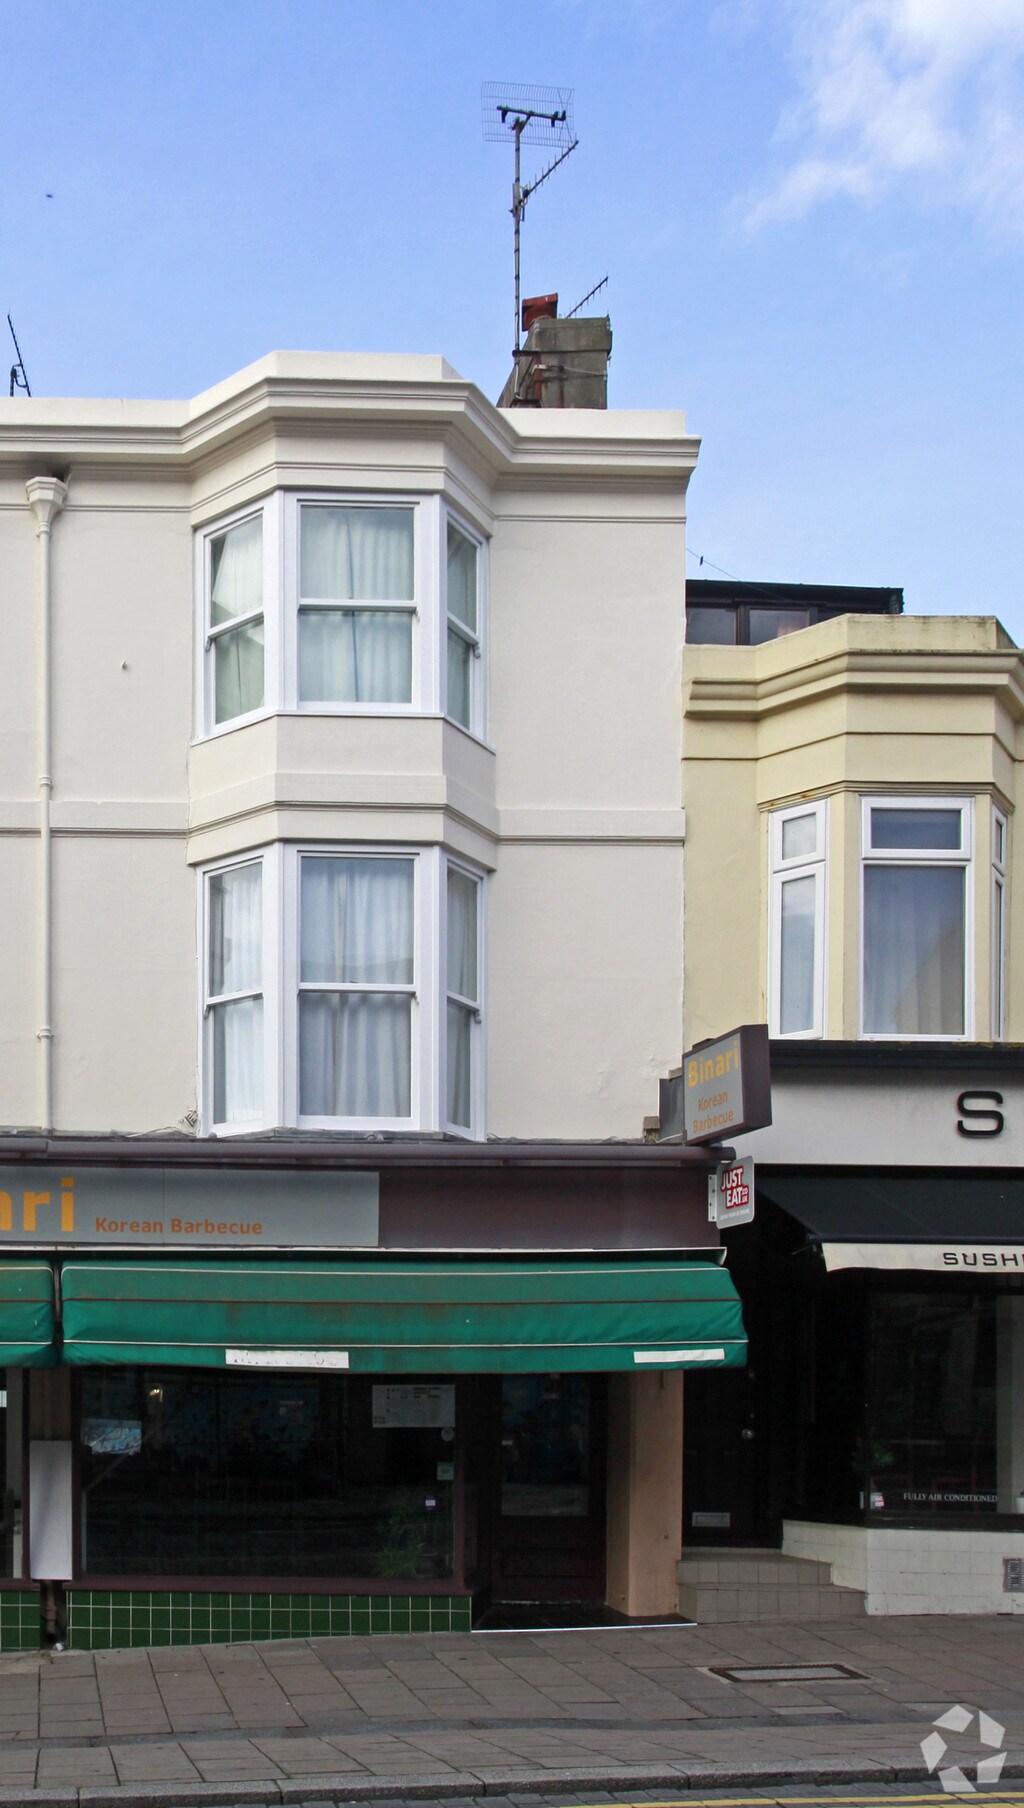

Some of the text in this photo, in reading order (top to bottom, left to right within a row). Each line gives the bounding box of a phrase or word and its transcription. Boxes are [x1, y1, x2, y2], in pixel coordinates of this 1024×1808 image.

[688, 1041, 739, 1087] Binari
[698, 1091, 728, 1112] Korean
[693, 1110, 733, 1134] Barbecue
[721, 1168, 742, 1190] JUST
[726, 1186, 742, 1207] EAT
[95, 1217, 263, 1235] Korean Barbecue
[944, 1494, 997, 1502] CONDITIONED
